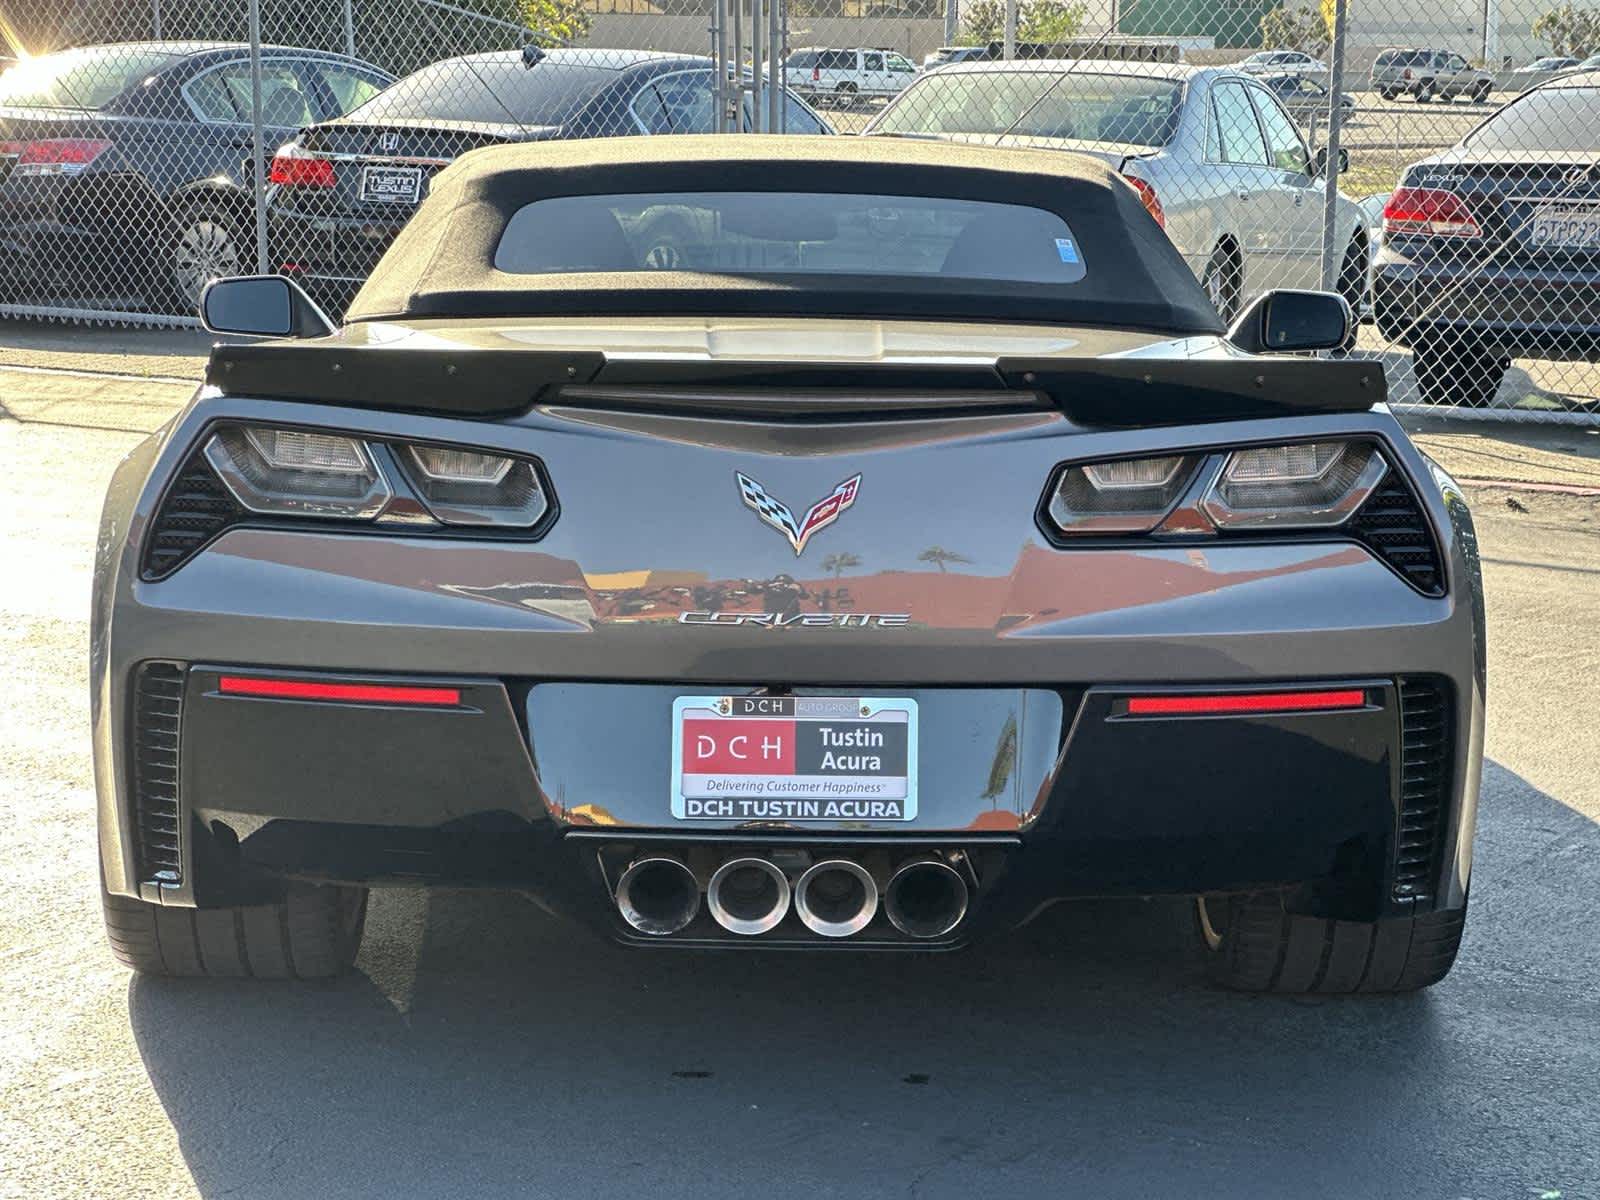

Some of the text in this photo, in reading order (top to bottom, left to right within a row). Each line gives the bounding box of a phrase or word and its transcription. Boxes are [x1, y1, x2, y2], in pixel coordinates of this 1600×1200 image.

[371, 184, 413, 193] LEXUS
[678, 611, 913, 627] CORVETTE
[745, 700, 783, 712] DCH
[820, 728, 883, 747] Tustin
[697, 735, 782, 759] DCH
[821, 752, 881, 770] Acura
[707, 780, 881, 794] Delivering Customer Happiness
[687, 800, 901, 817] DCH TUSTIN ACURA
